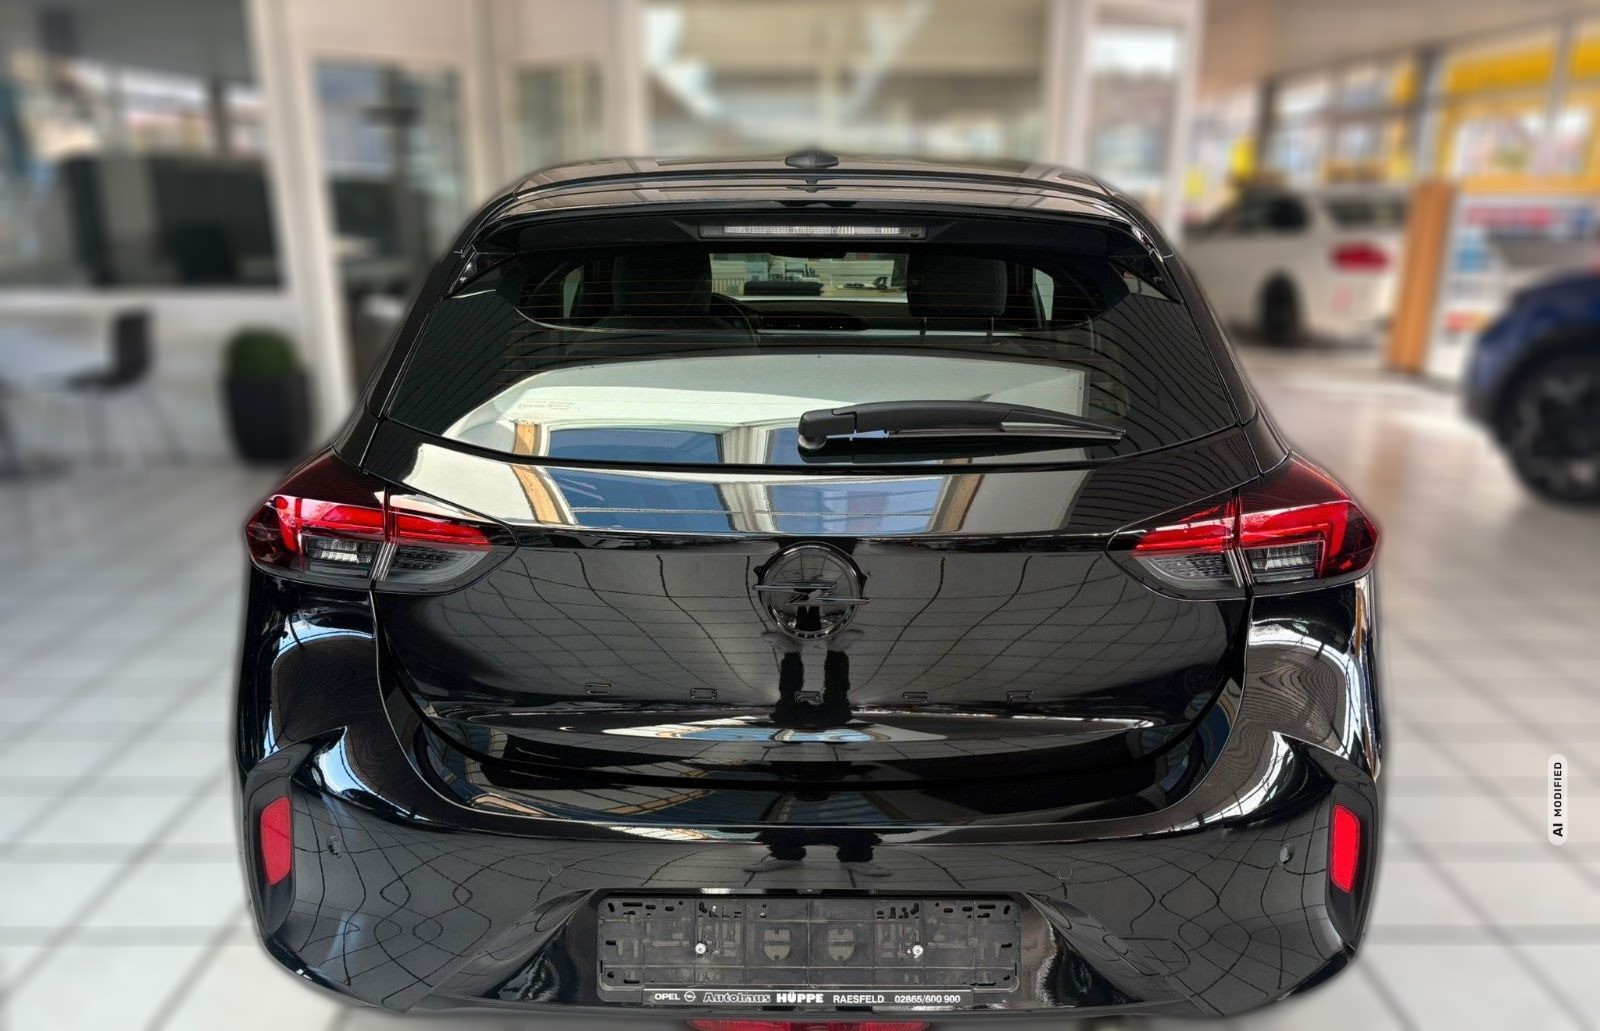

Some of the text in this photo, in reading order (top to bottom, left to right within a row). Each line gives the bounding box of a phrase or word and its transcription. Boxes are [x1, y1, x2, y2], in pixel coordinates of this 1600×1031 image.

[654, 991, 961, 1004] OPEL Autohaus HÜPPE RAESFELD 02865/600 900
